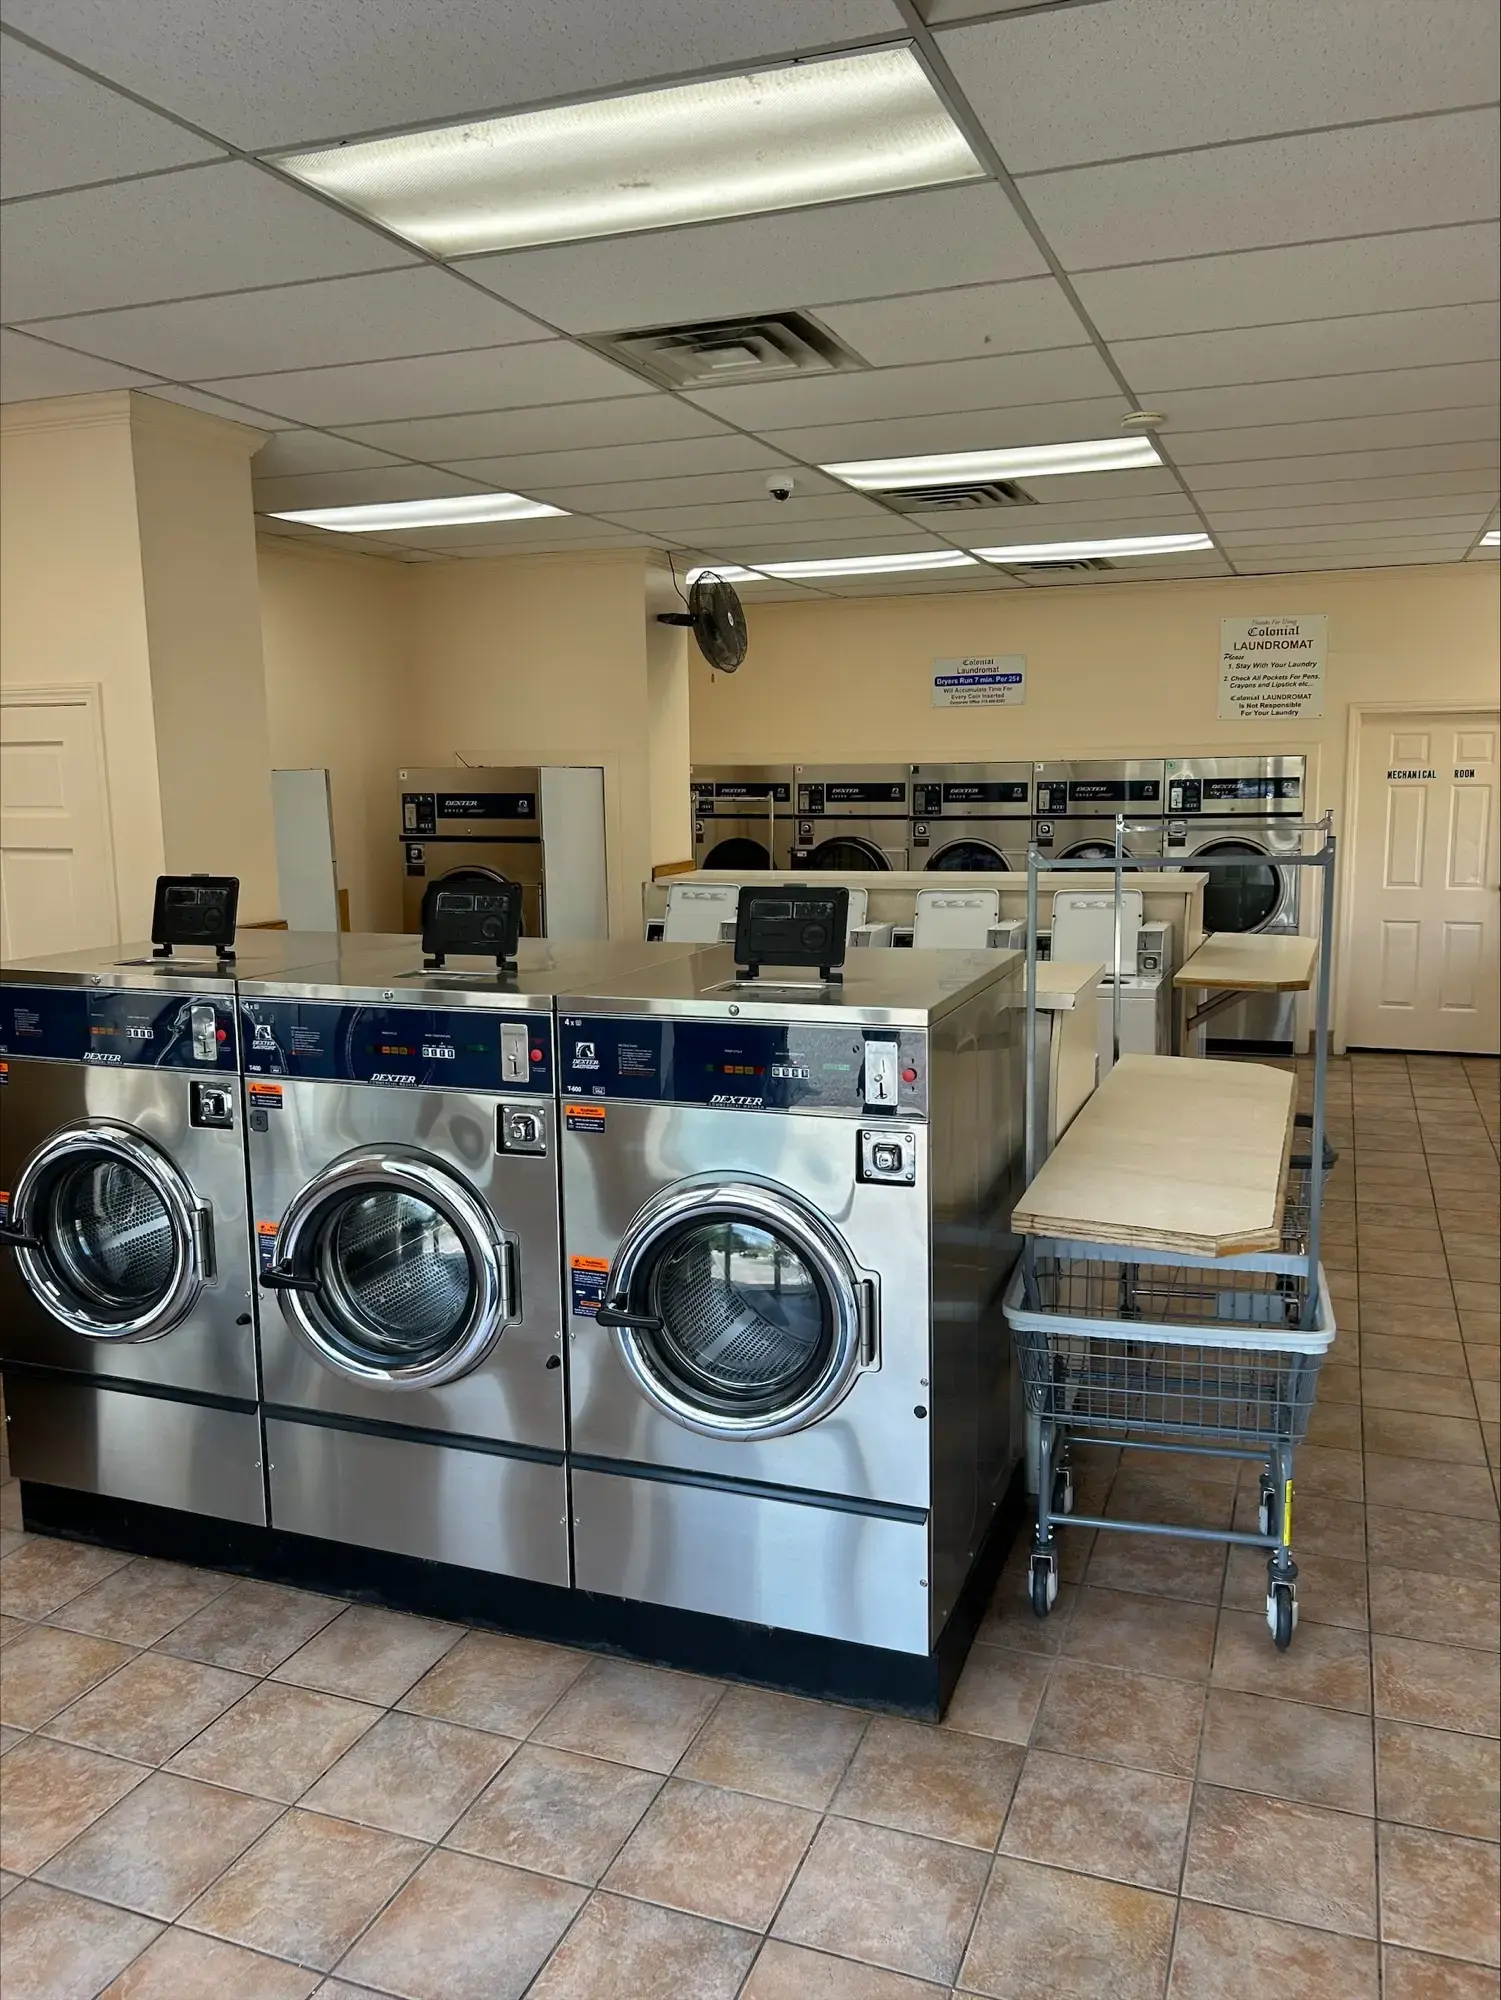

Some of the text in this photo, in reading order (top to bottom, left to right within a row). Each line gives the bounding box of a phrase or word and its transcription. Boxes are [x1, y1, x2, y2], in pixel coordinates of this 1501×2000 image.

[1248, 626, 1300, 637] Colonial
[1234, 640, 1314, 651] LAUNDROMAT
[962, 658, 994, 666] Colonial
[1235, 662, 1252, 670] Stay
[1288, 661, 1318, 669] Laundry
[956, 666, 1000, 674] Laundromat
[937, 678, 958, 686] Dryers
[1271, 681, 1297, 689] Lipstick
[1259, 701, 1302, 709] Responsible
[1271, 709, 1300, 717] Laundry
[1387, 769, 1475, 779] MECHANICAL ROOM
[83, 1052, 121, 1062] DEXTER
[371, 1073, 416, 1083] DEXTER
[710, 1094, 763, 1106] DEXTER
